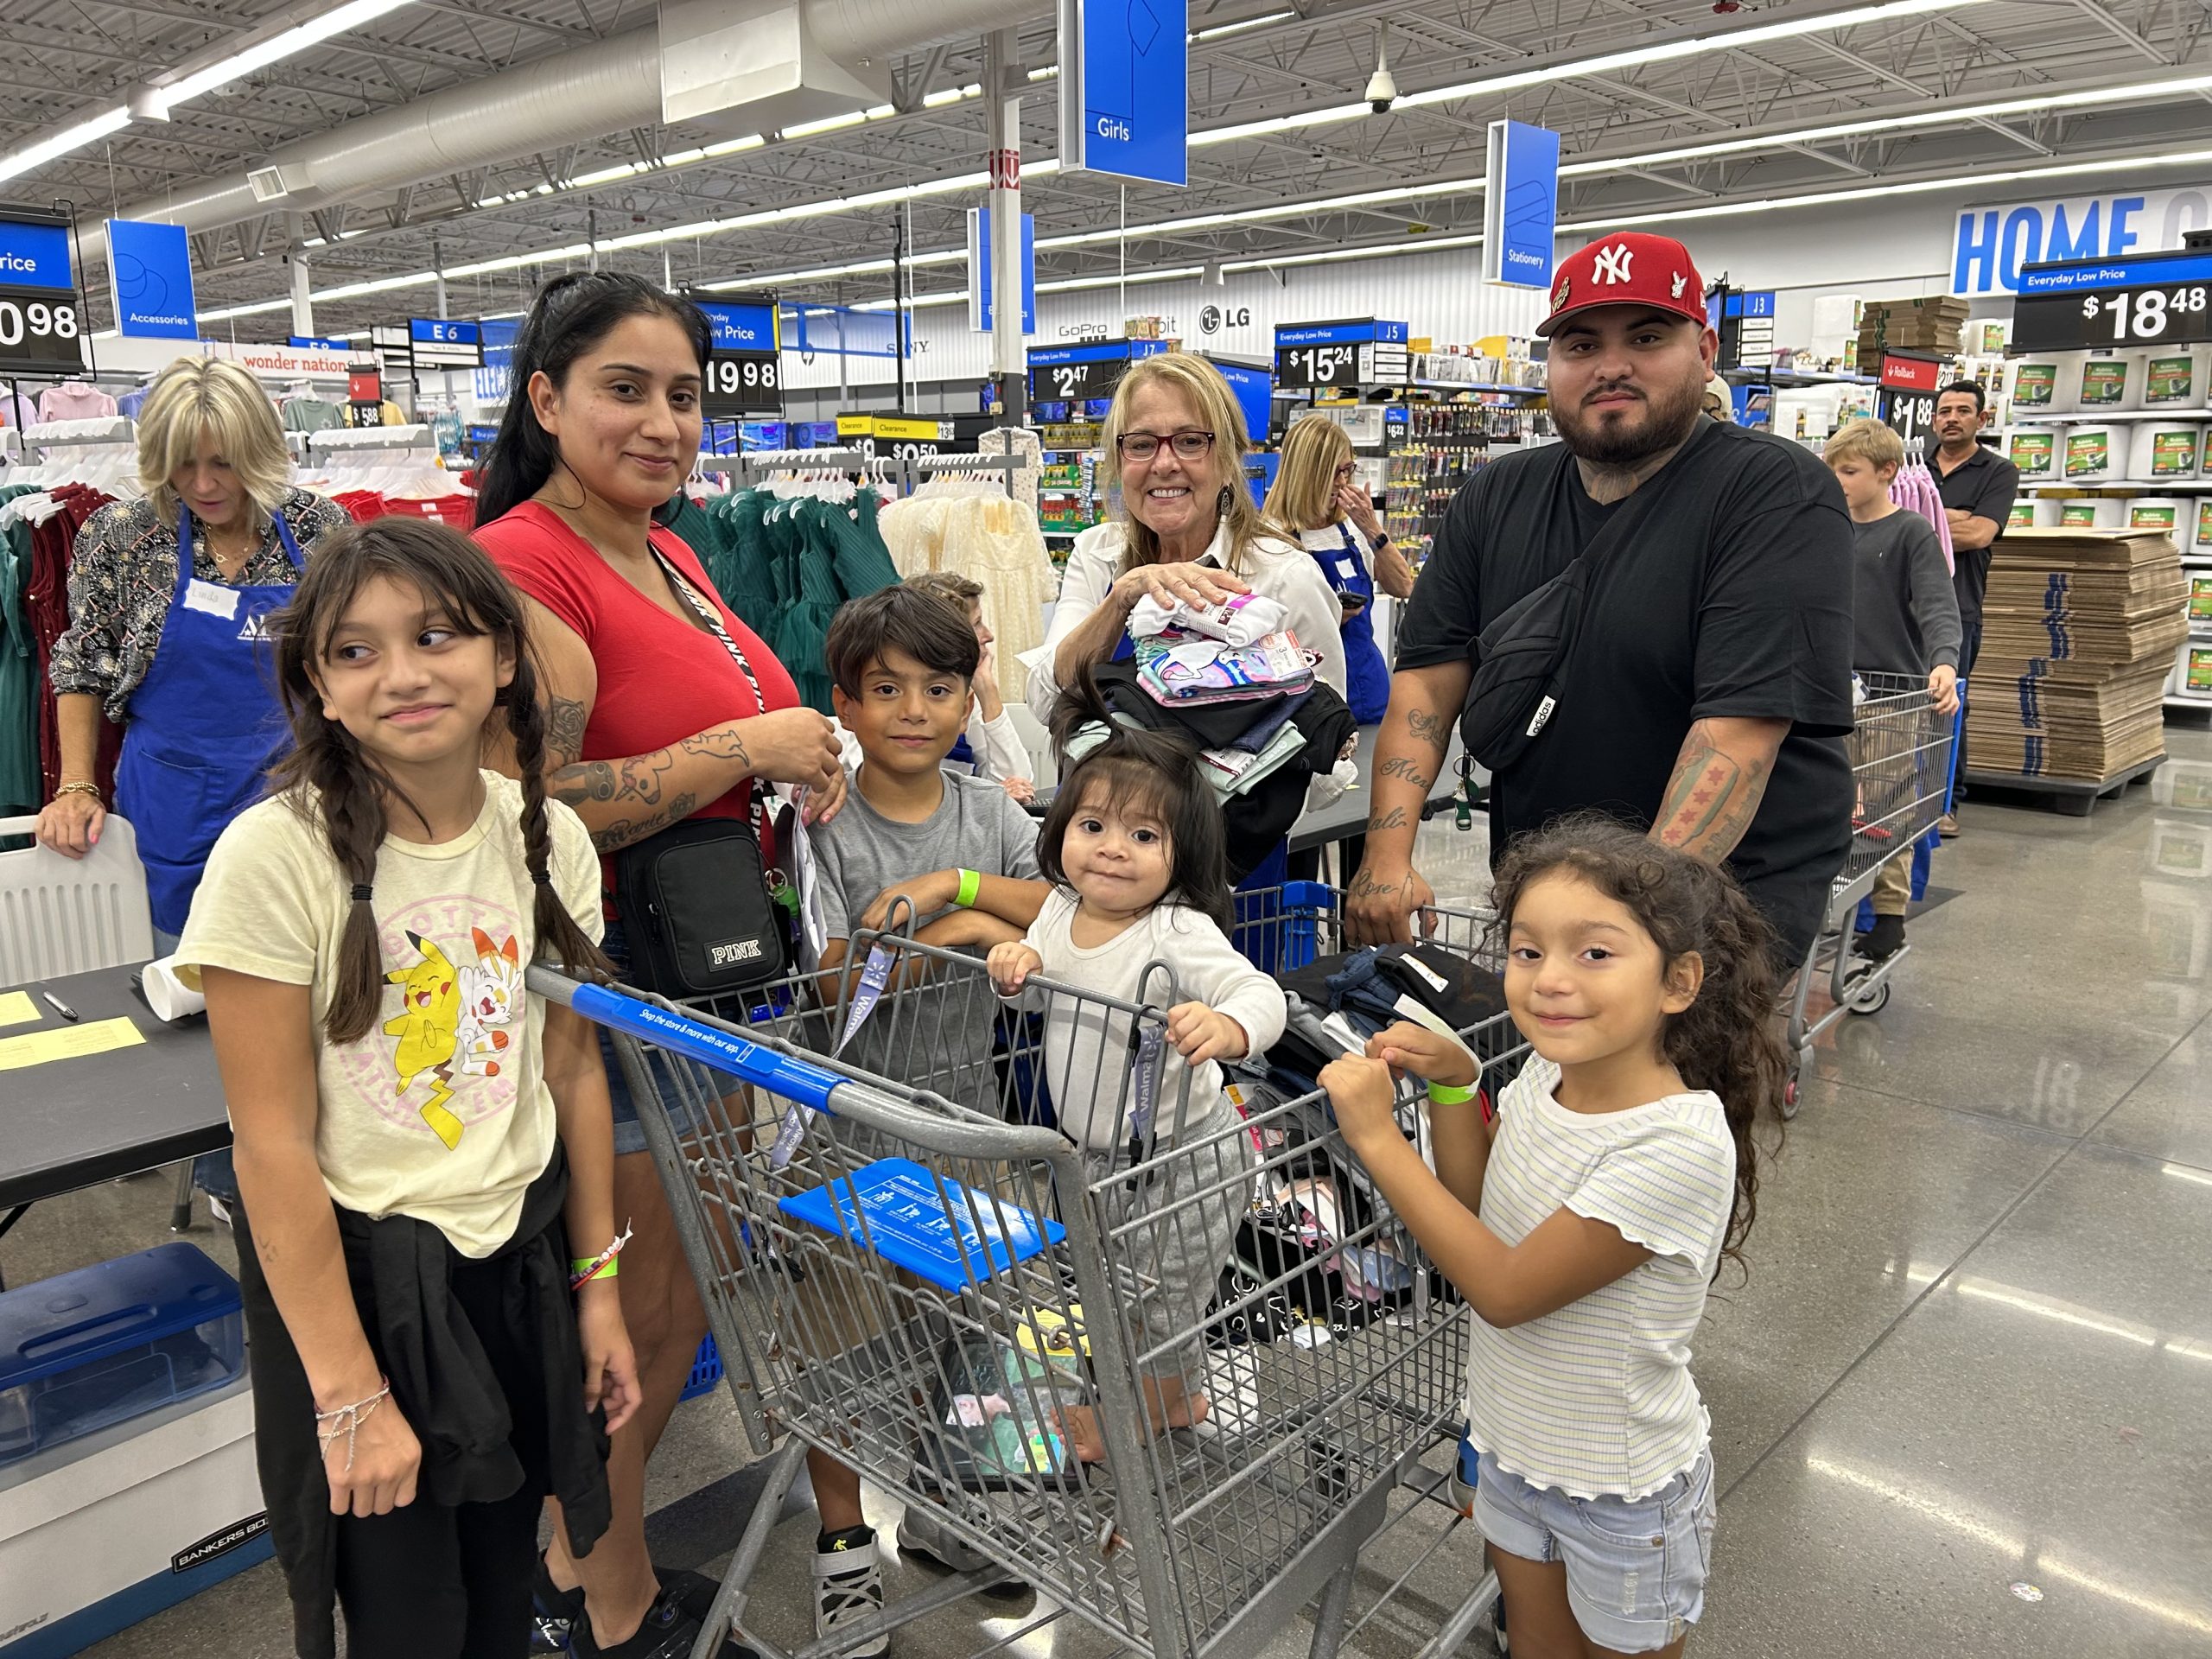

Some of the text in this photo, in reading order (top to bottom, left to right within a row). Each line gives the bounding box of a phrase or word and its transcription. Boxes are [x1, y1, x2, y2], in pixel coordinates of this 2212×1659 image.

[1097, 118, 1130, 142] Girls
[1954, 196, 2145, 294] HOME
[1508, 249, 1544, 270] Stationery
[1591, 243, 1634, 284] NY
[2027, 269, 2126, 287] Everyday Low Price
[1753, 296, 1765, 314] J 3
[130, 312, 188, 326] Accessories
[1225, 308, 1249, 327] LG
[433, 324, 458, 340] E 6
[725, 325, 755, 340] Price
[1058, 323, 1108, 337] GoPro
[1280, 331, 1305, 341] Everyday
[1318, 330, 1332, 339] Price
[1386, 325, 1398, 340] J 5
[887, 340, 930, 354] SNY
[243, 351, 346, 373] wonder nation
[1030, 353, 1050, 363] Everyday
[1224, 372, 1249, 384] Low Price
[1893, 365, 1916, 380] Rollback
[879, 424, 907, 433] Clearance
[672, 576, 766, 715] PINK PINK PIN
[1533, 701, 1552, 734] adidas
[750, 802, 761, 842] PIN
[384, 905, 512, 956] GOTTA
[711, 939, 762, 965] PINK
[639, 1008, 740, 1054] Shop the store & more with our app.
[1140, 1052, 1156, 1113] Walmat
[179, 1529, 245, 1566] BANKERS
